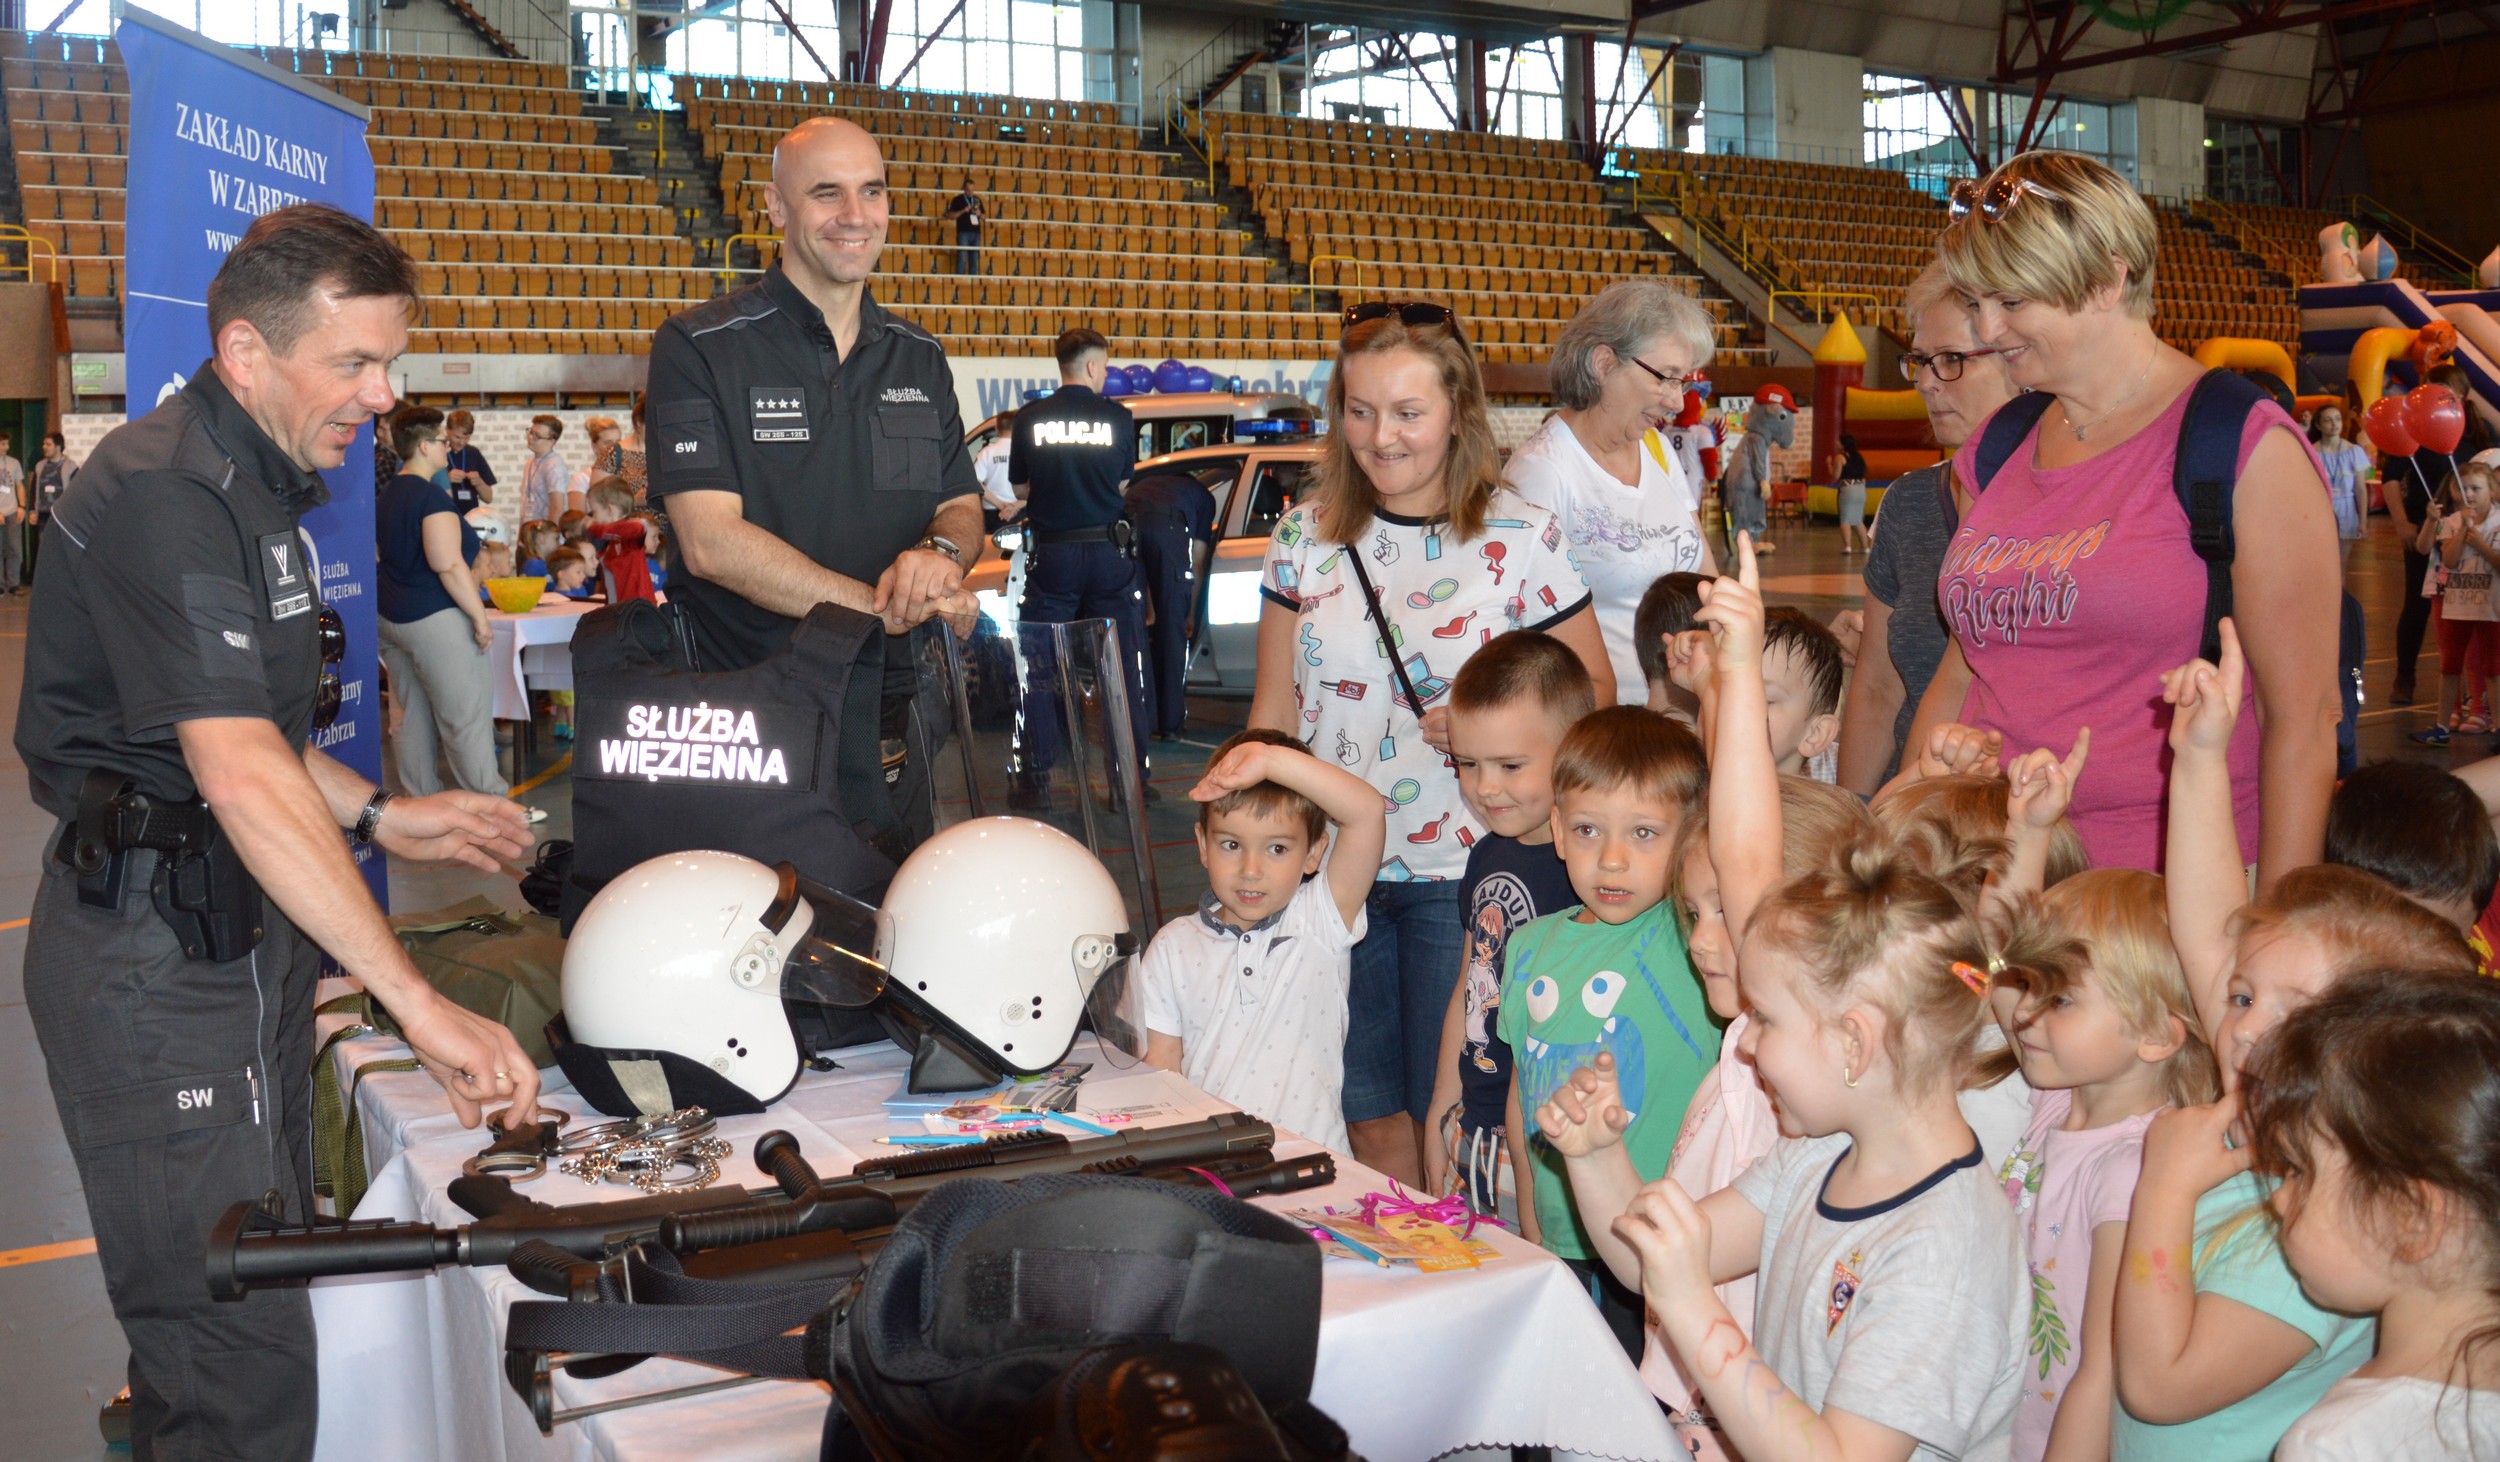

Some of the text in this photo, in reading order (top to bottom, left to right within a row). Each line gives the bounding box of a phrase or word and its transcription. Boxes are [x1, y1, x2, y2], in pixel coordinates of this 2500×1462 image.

[176, 102, 328, 185] ZAKŁAD KARNY
[208, 169, 229, 207] W
[880, 393, 930, 403] WIĘZIENNA
[886, 386, 922, 396] SŁUŻBA
[1033, 420, 1113, 447] POLICJA
[1673, 435, 1683, 450] 8
[675, 441, 698, 453] SW
[323, 561, 349, 580] SŁUŻBA
[324, 582, 362, 603] WIĘZIENNA
[1944, 566, 2079, 648] Right
[223, 630, 250, 650] SW
[340, 680, 362, 705] arny
[626, 701, 759, 745] SŁUŻBA
[600, 739, 788, 784] WIĘZIENNA
[177, 1087, 213, 1110] SW
